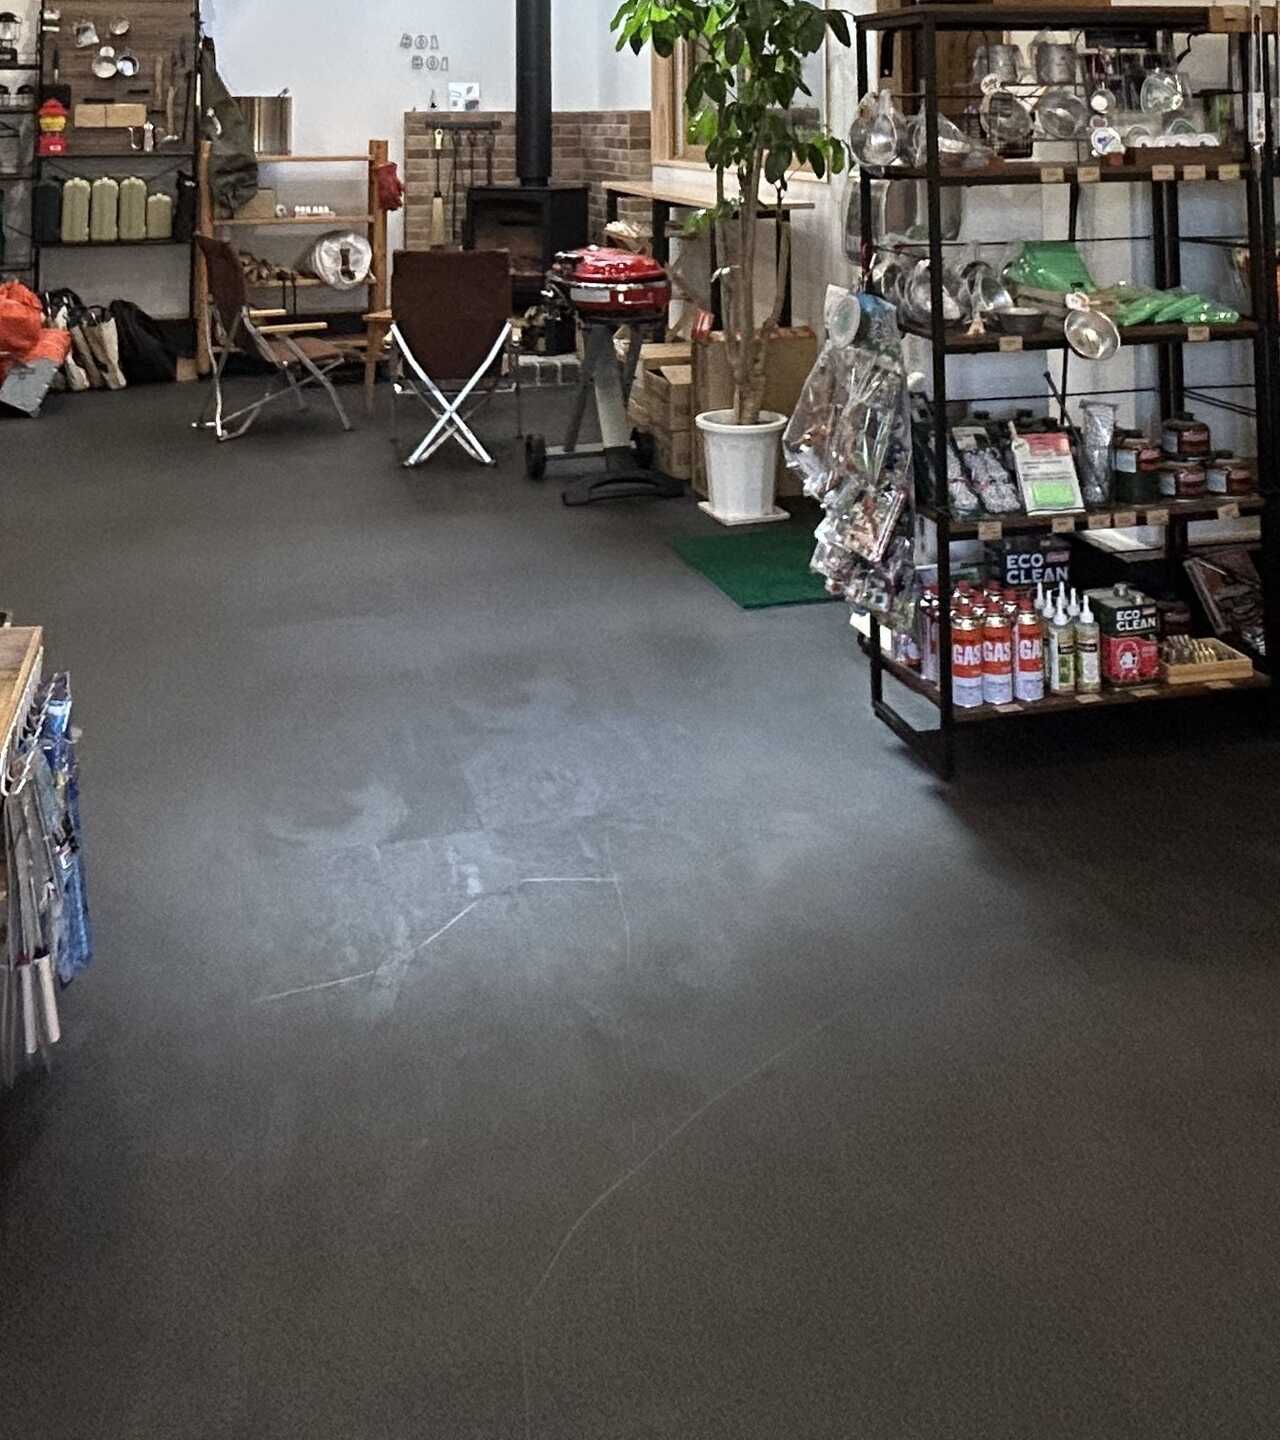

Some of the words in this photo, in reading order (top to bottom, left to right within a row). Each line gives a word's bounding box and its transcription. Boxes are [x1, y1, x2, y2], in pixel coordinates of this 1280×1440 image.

[1006, 553, 1044, 569] ECO
[1006, 567, 1070, 584] CLEAN
[1115, 610, 1141, 622] ECO
[1115, 617, 1157, 632] CLEAN
[952, 644, 982, 665] GAS
[983, 641, 1011, 662] GAS
[1020, 639, 1042, 660] GA
